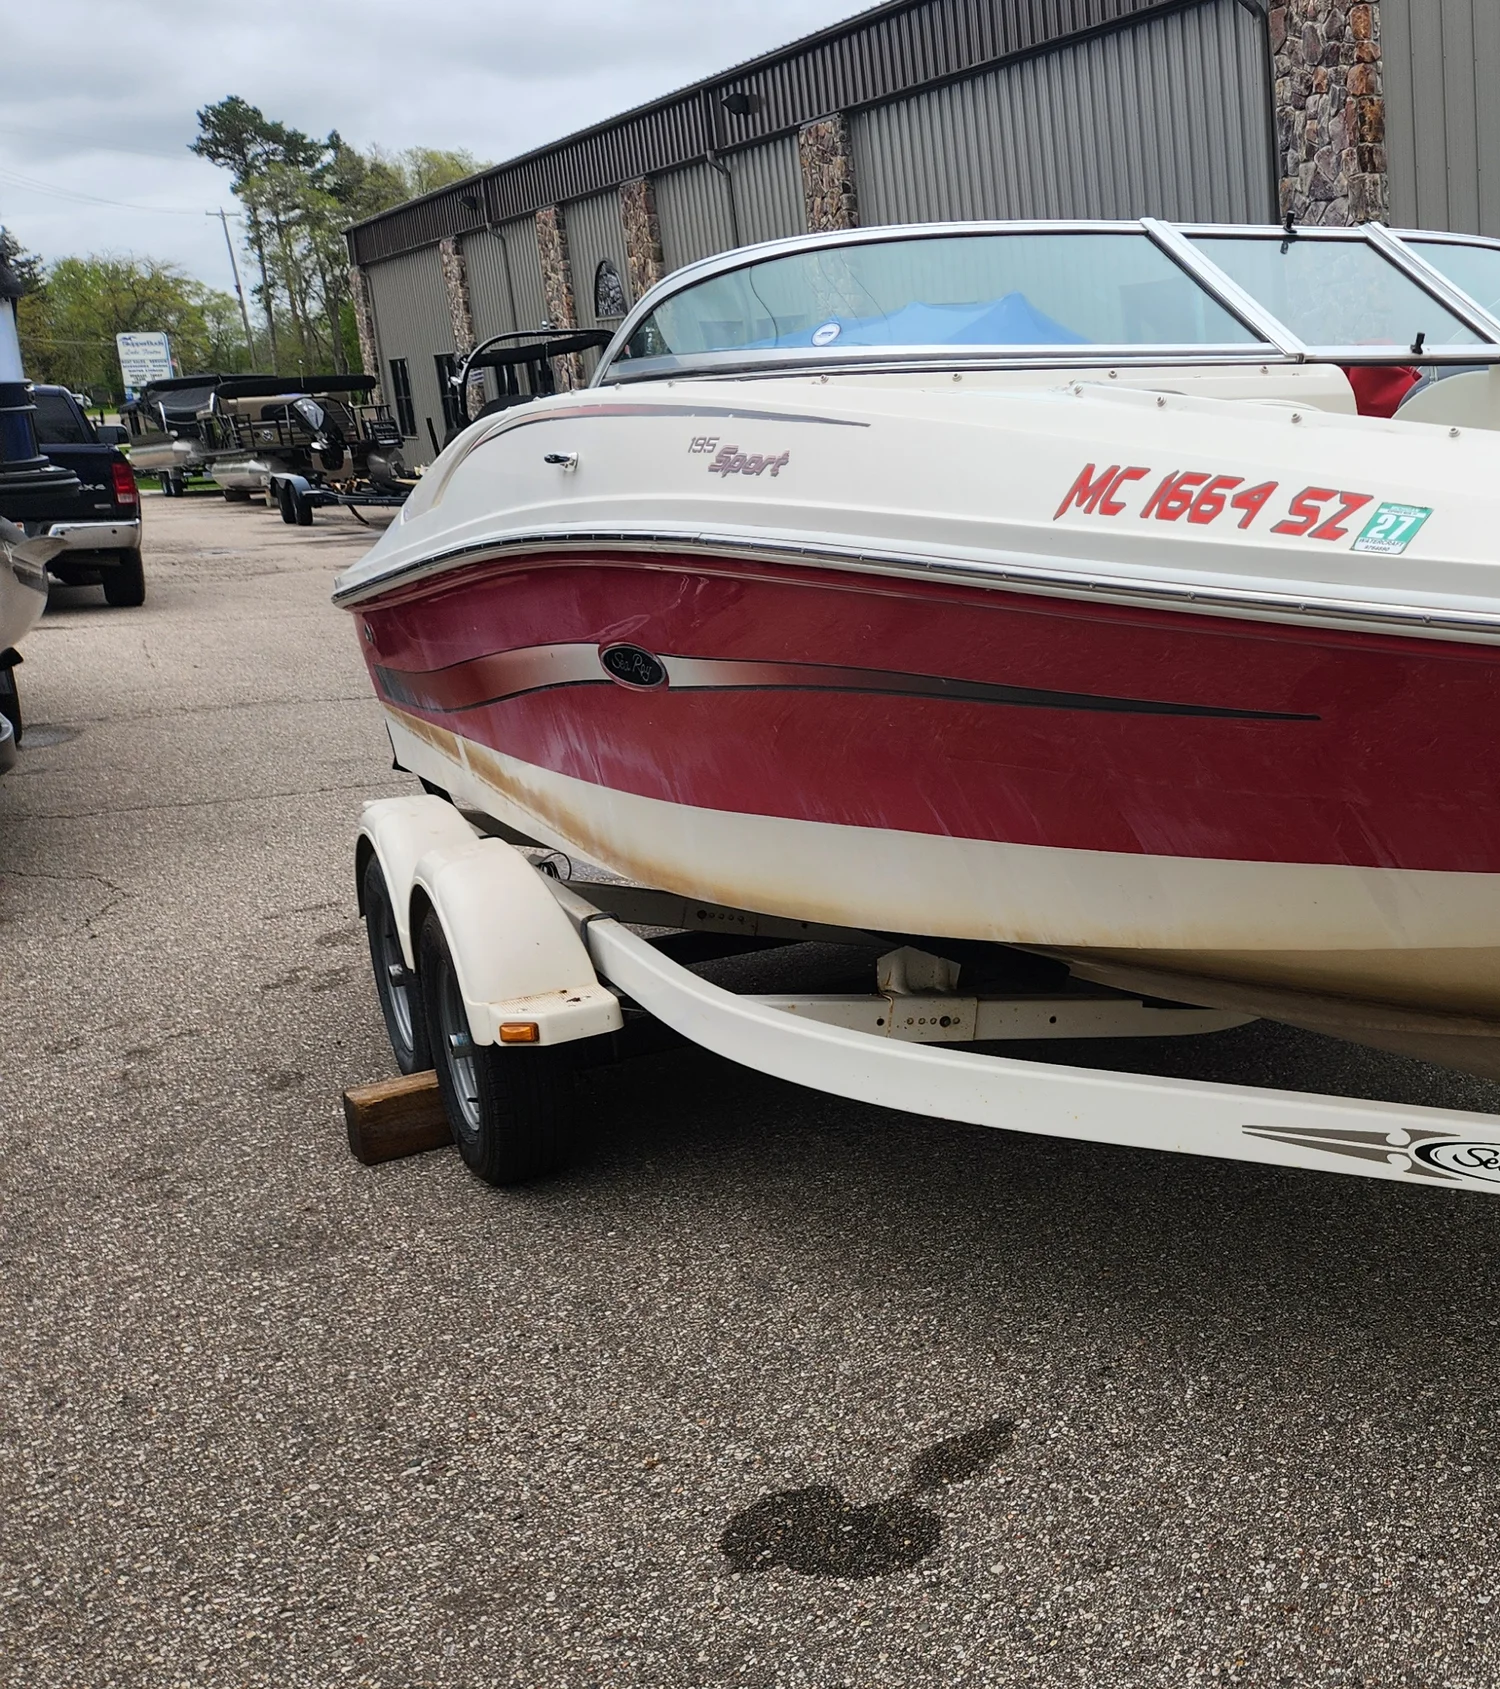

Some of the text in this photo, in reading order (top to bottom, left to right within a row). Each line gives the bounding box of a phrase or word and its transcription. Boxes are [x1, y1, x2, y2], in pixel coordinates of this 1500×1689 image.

[688, 436, 720, 453] 195
[708, 445, 790, 478] Sport
[1053, 463, 1374, 541] MC 1664 SZ
[1367, 513, 1416, 541] 27
[1359, 538, 1404, 548] WATERCRAFT
[612, 652, 652, 682] Sea Ray
